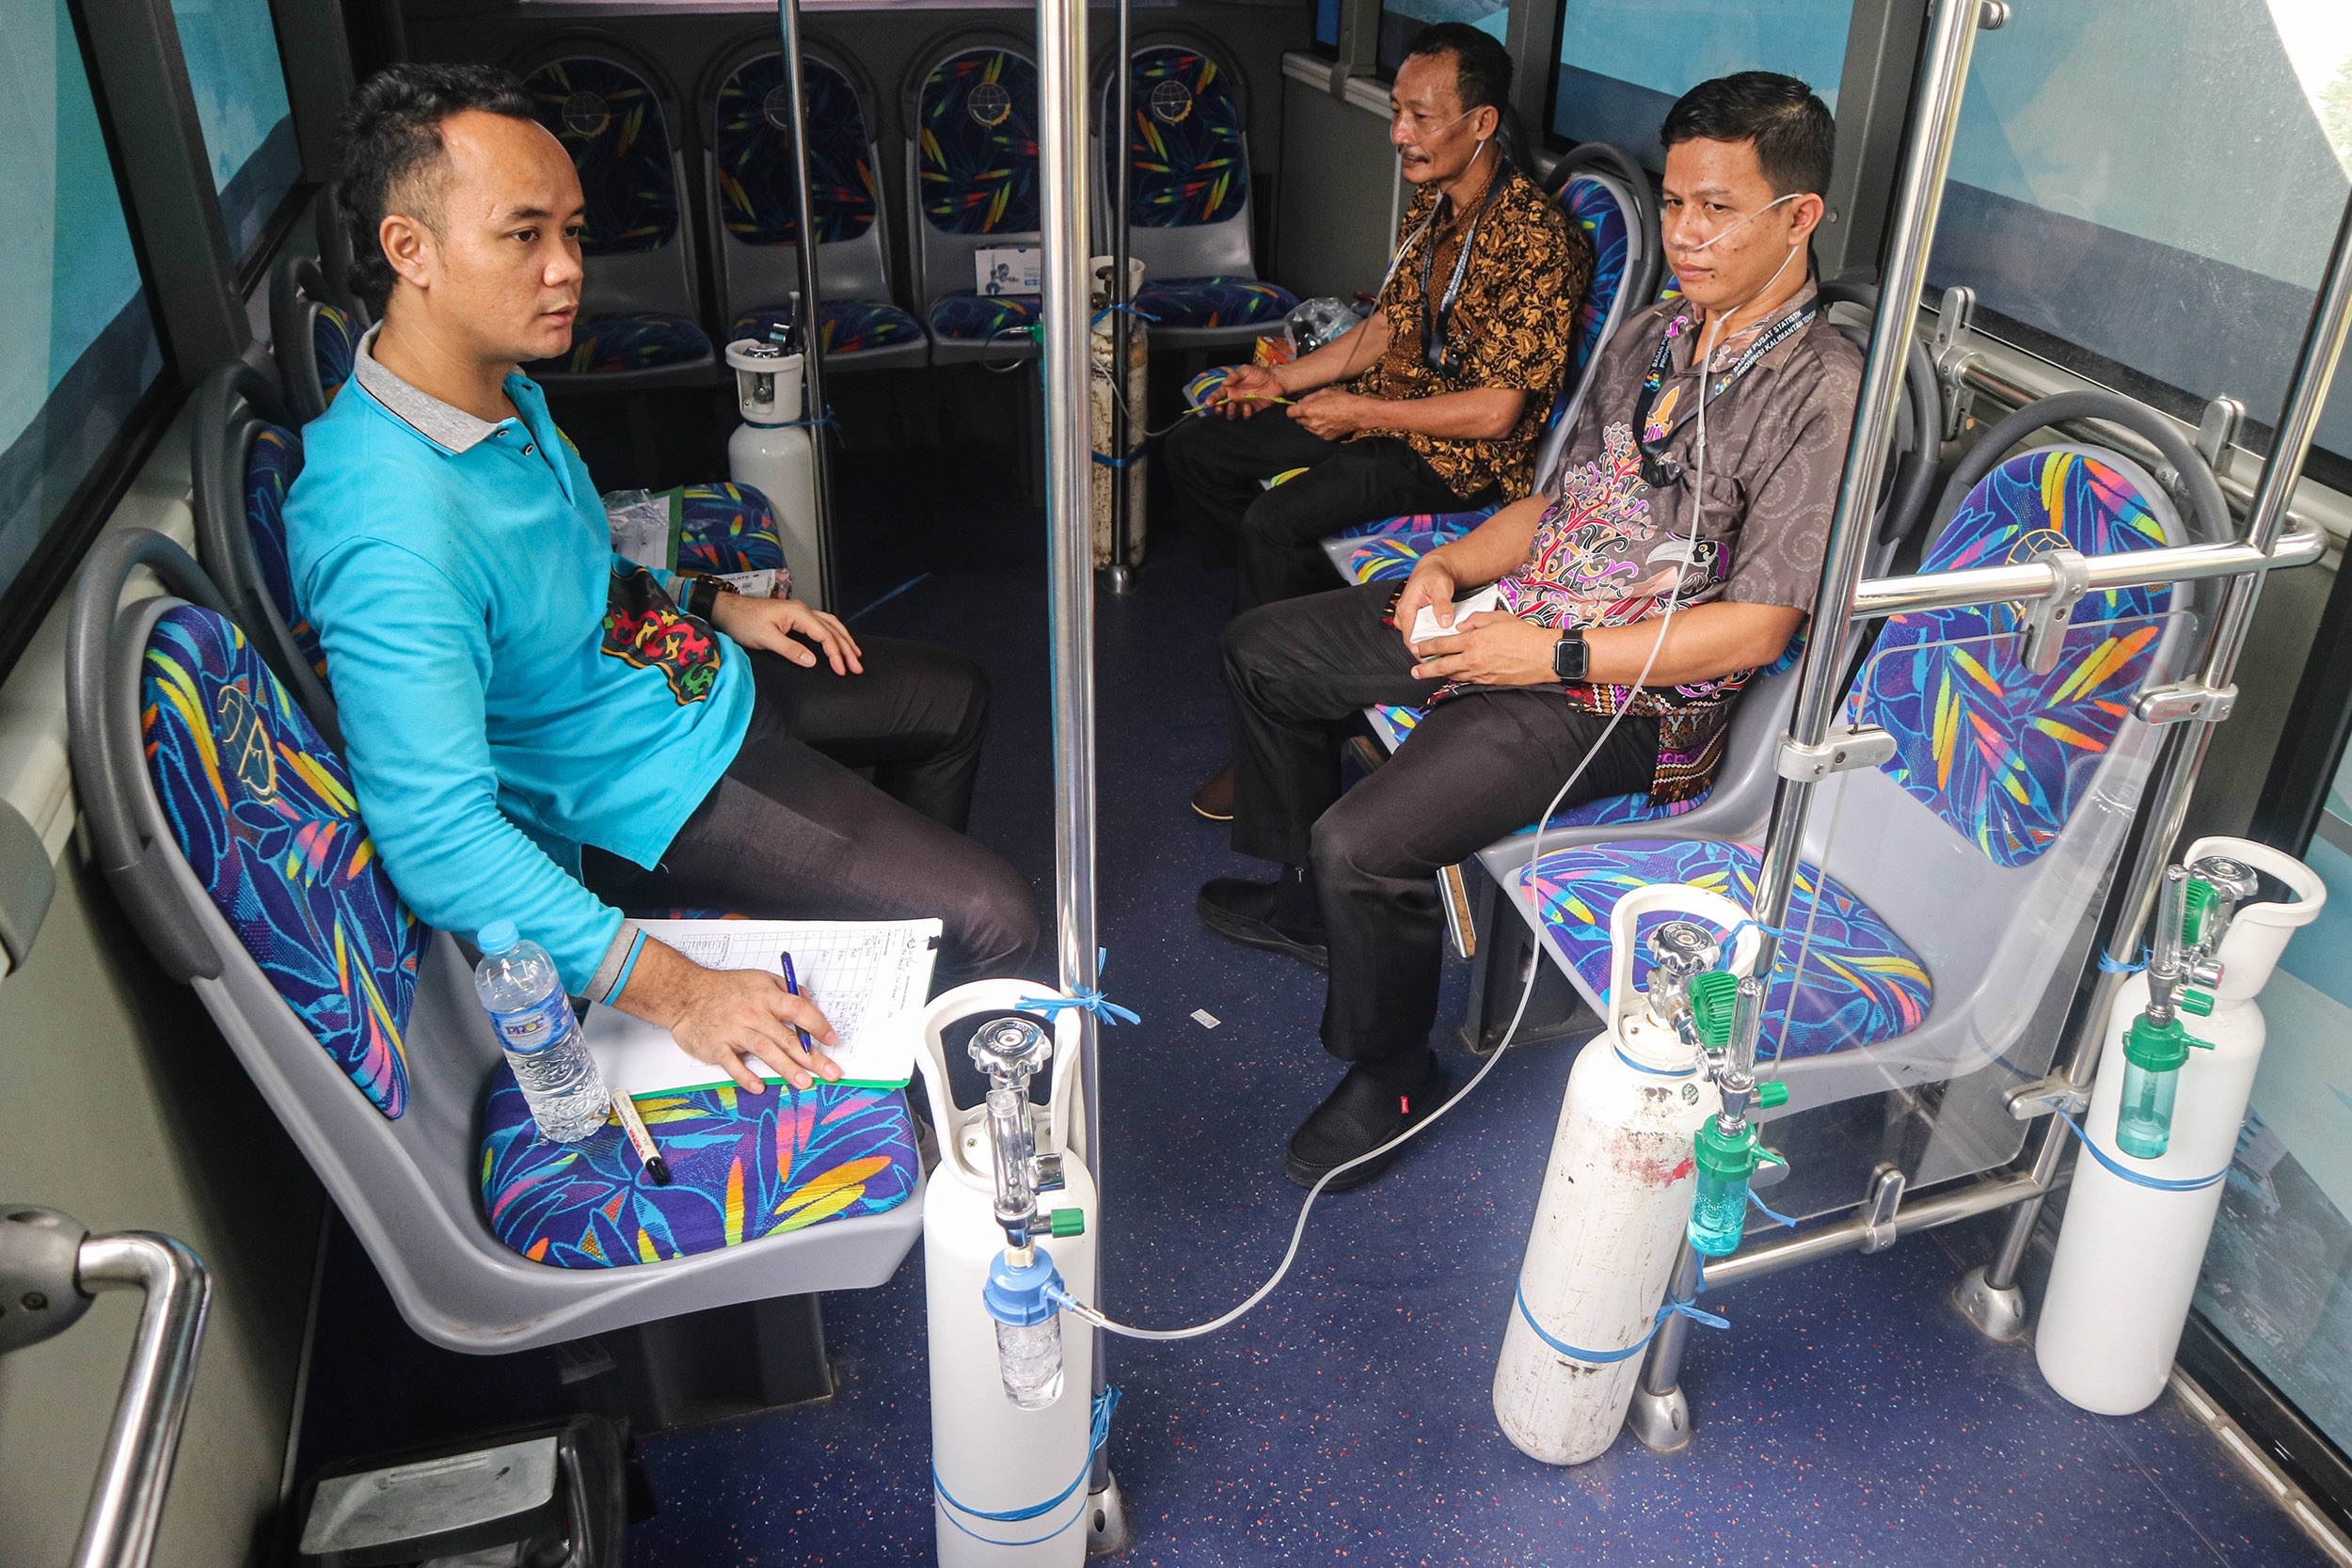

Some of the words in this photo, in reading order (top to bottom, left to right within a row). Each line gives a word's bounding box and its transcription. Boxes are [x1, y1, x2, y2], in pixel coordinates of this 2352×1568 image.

[1652, 346, 1664, 368] BADAN
[1733, 350, 1753, 372] BADAN
[1752, 331, 1773, 351] PUSAT
[1772, 309, 1803, 333] STATISTIK
[1737, 350, 1766, 376] PROVINSI
[1765, 322, 1804, 352] KALIMANTAN
